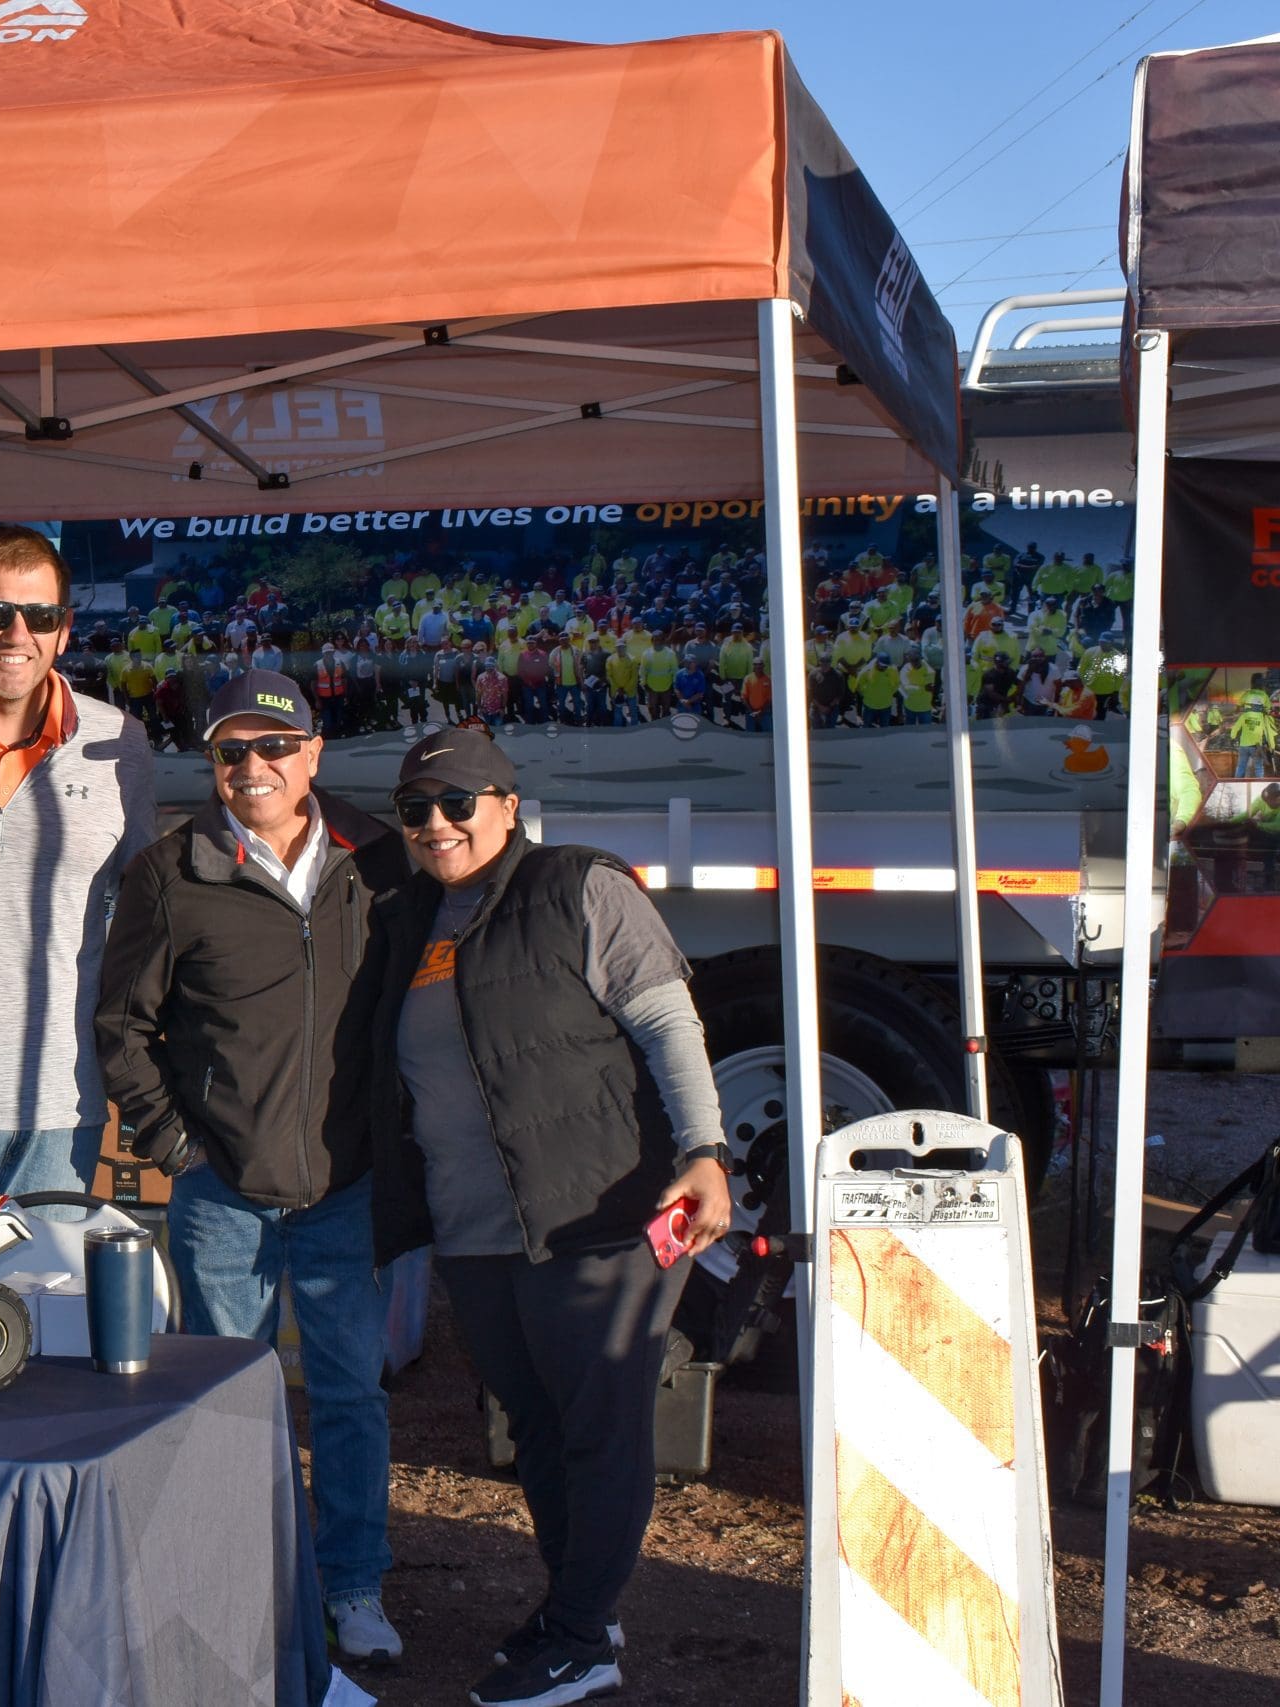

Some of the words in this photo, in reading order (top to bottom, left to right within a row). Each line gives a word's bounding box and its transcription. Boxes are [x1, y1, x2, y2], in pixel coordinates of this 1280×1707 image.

[119, 516, 175, 539] We
[186, 513, 291, 537] build
[301, 510, 430, 534] better
[441, 506, 533, 528] lives
[544, 503, 623, 526] one
[636, 495, 904, 528] opporunity
[914, 493, 938, 513] a
[972, 493, 996, 512] a
[1009, 483, 1125, 511] time.
[257, 693, 294, 712] FELIX
[975, 1210, 994, 1219] Yuma
